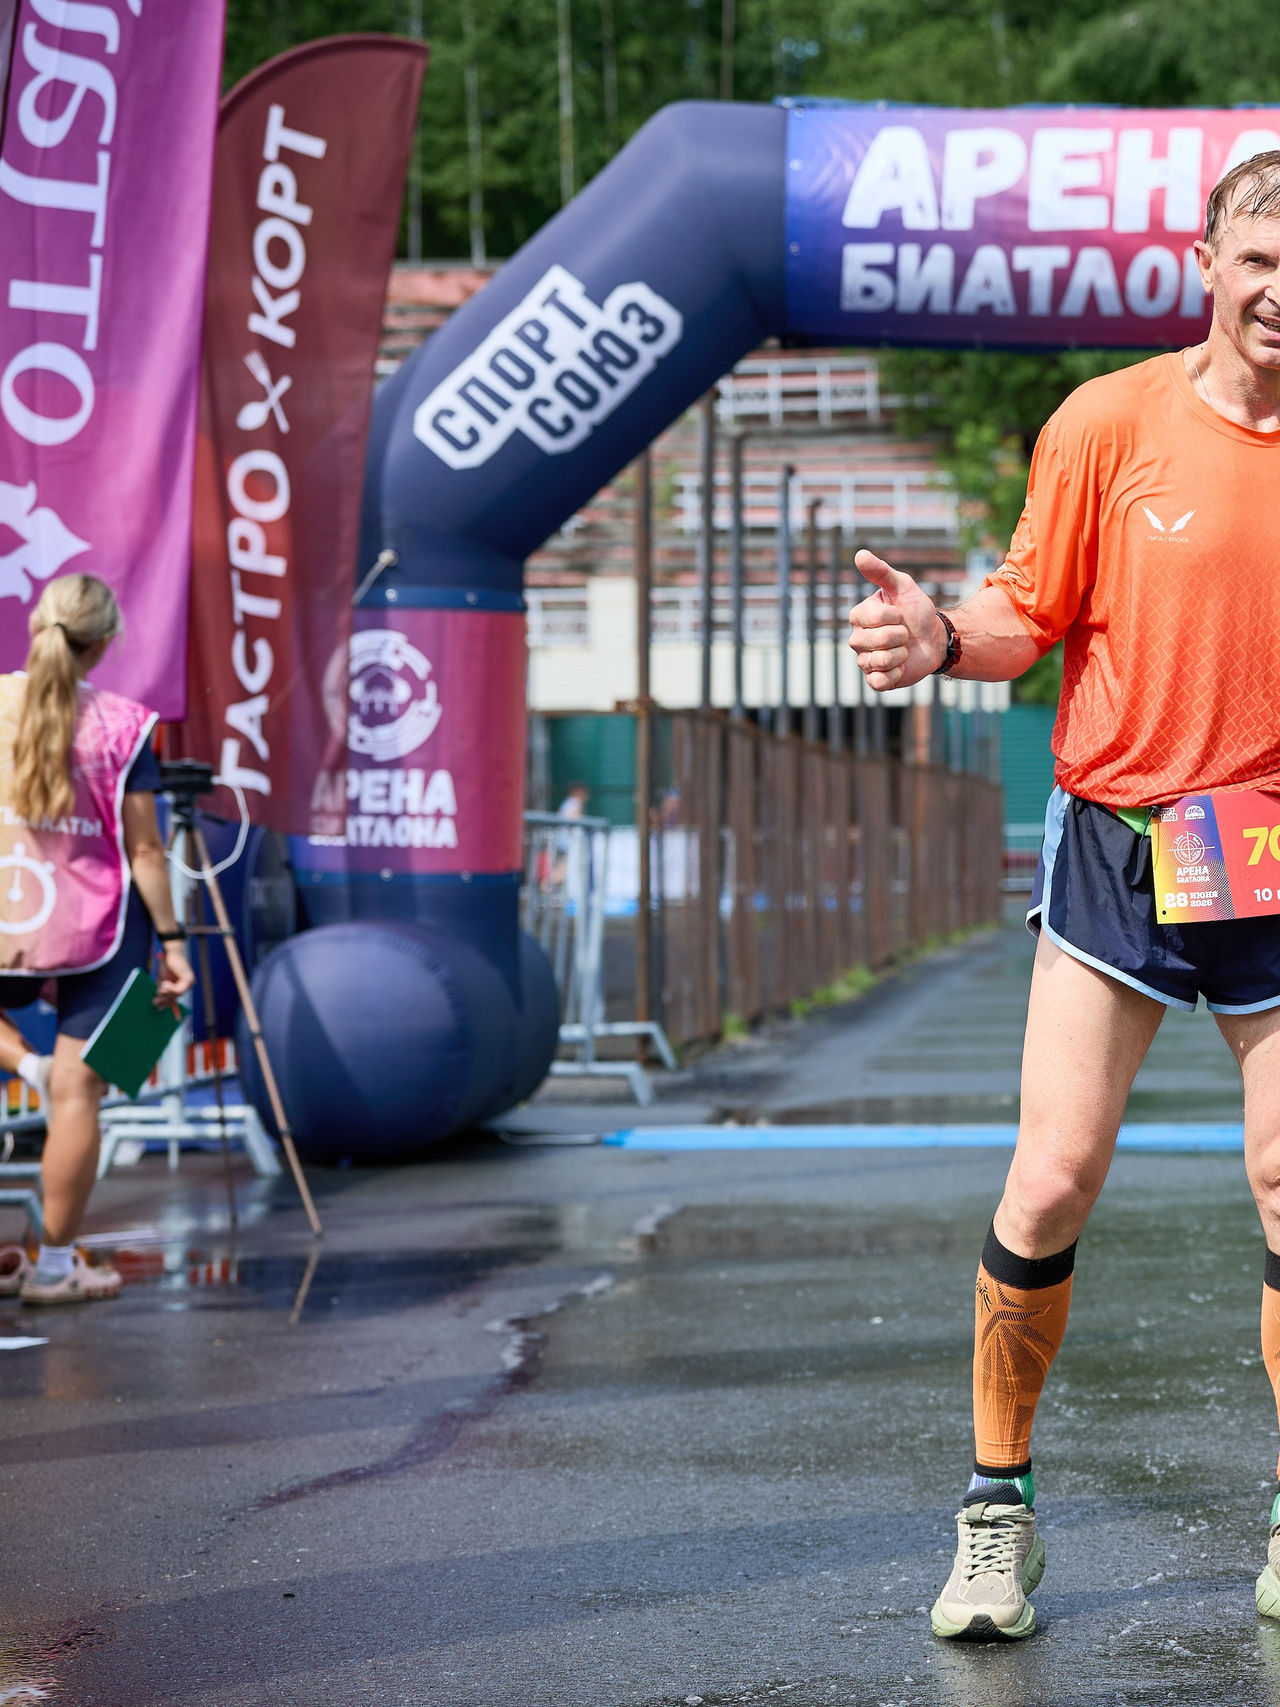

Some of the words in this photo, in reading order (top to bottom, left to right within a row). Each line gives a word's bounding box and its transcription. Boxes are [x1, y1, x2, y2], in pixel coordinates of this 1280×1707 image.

[247, 104, 327, 348] КОРТ
[431, 288, 588, 451] СПОРТ
[527, 302, 665, 438] СОЮЗ
[220, 449, 291, 796] ГАСТРО
[1164, 892, 1188, 908] 28
[1176, 865, 1209, 876] АРЕНА
[1253, 888, 1273, 902] 10
